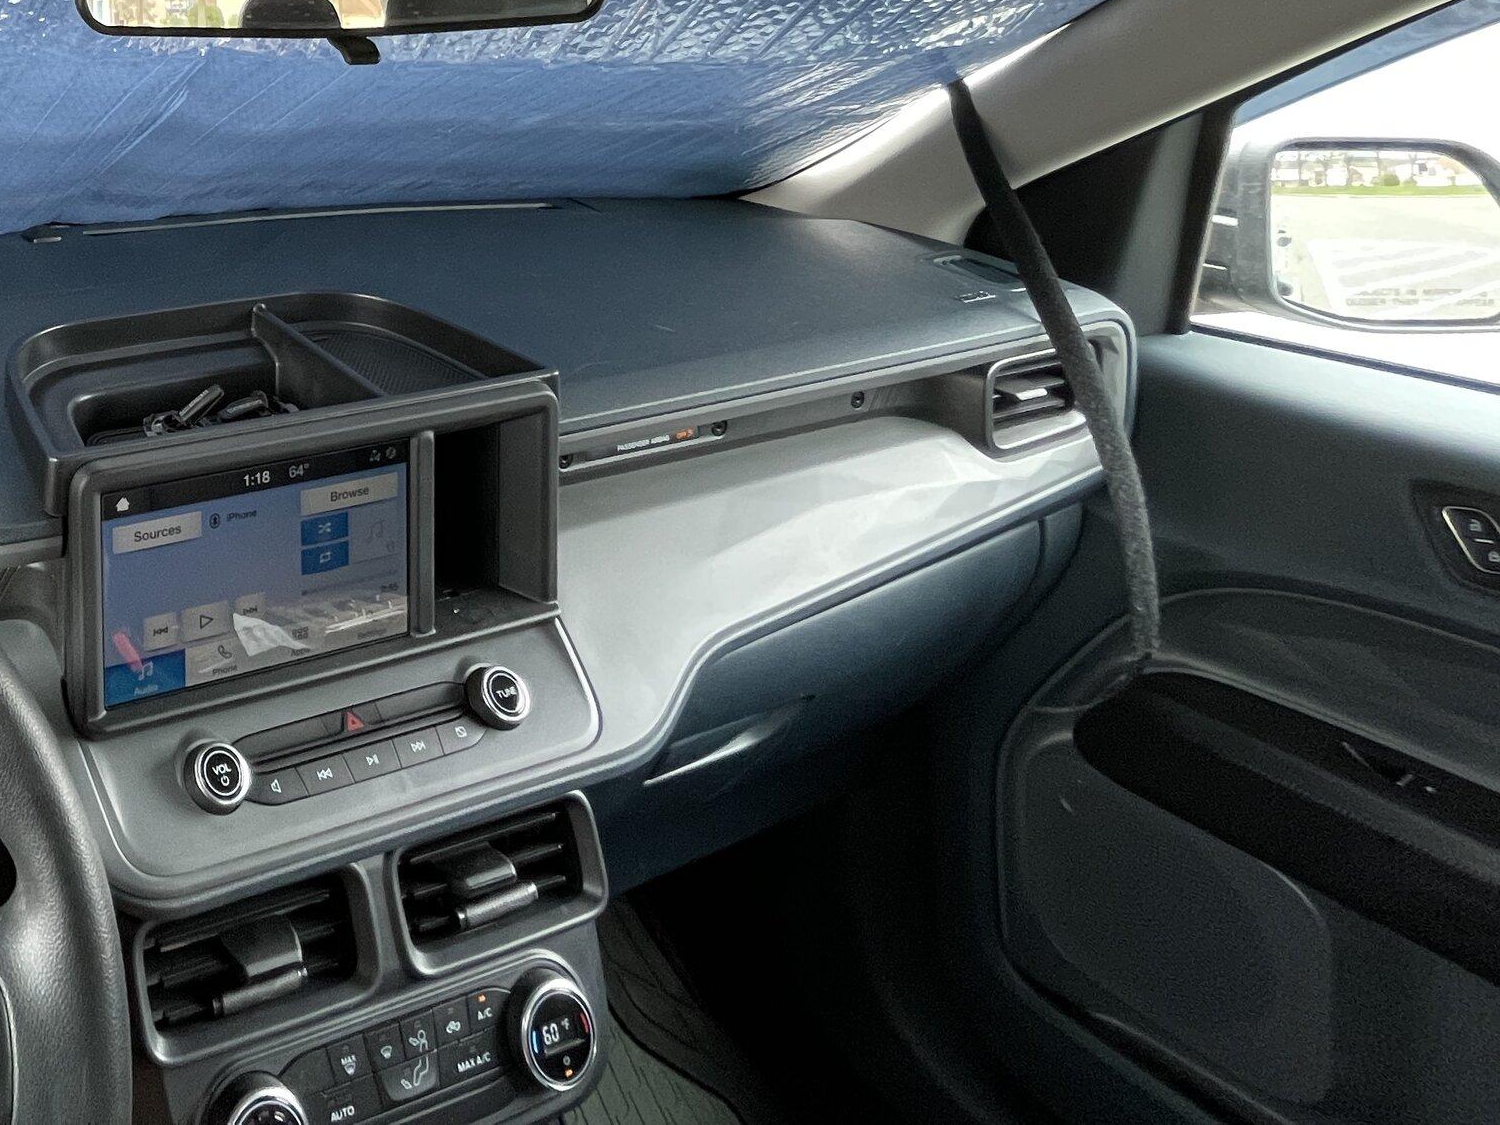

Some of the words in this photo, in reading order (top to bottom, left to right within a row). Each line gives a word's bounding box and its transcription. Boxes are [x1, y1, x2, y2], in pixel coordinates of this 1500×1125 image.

[243, 470, 270, 487] 1:18
[288, 463, 309, 478] 64°
[330, 485, 369, 502] Browse
[226, 509, 257, 522] iPhone
[134, 524, 182, 543] Sources
[212, 763, 232, 775] VOL
[477, 1007, 493, 1021] A/C
[542, 1023, 560, 1046] 60
[340, 1054, 357, 1065] MAX
[457, 1057, 476, 1073] MAX
[475, 1052, 491, 1065] A/C
[330, 1105, 355, 1123] AUTO
